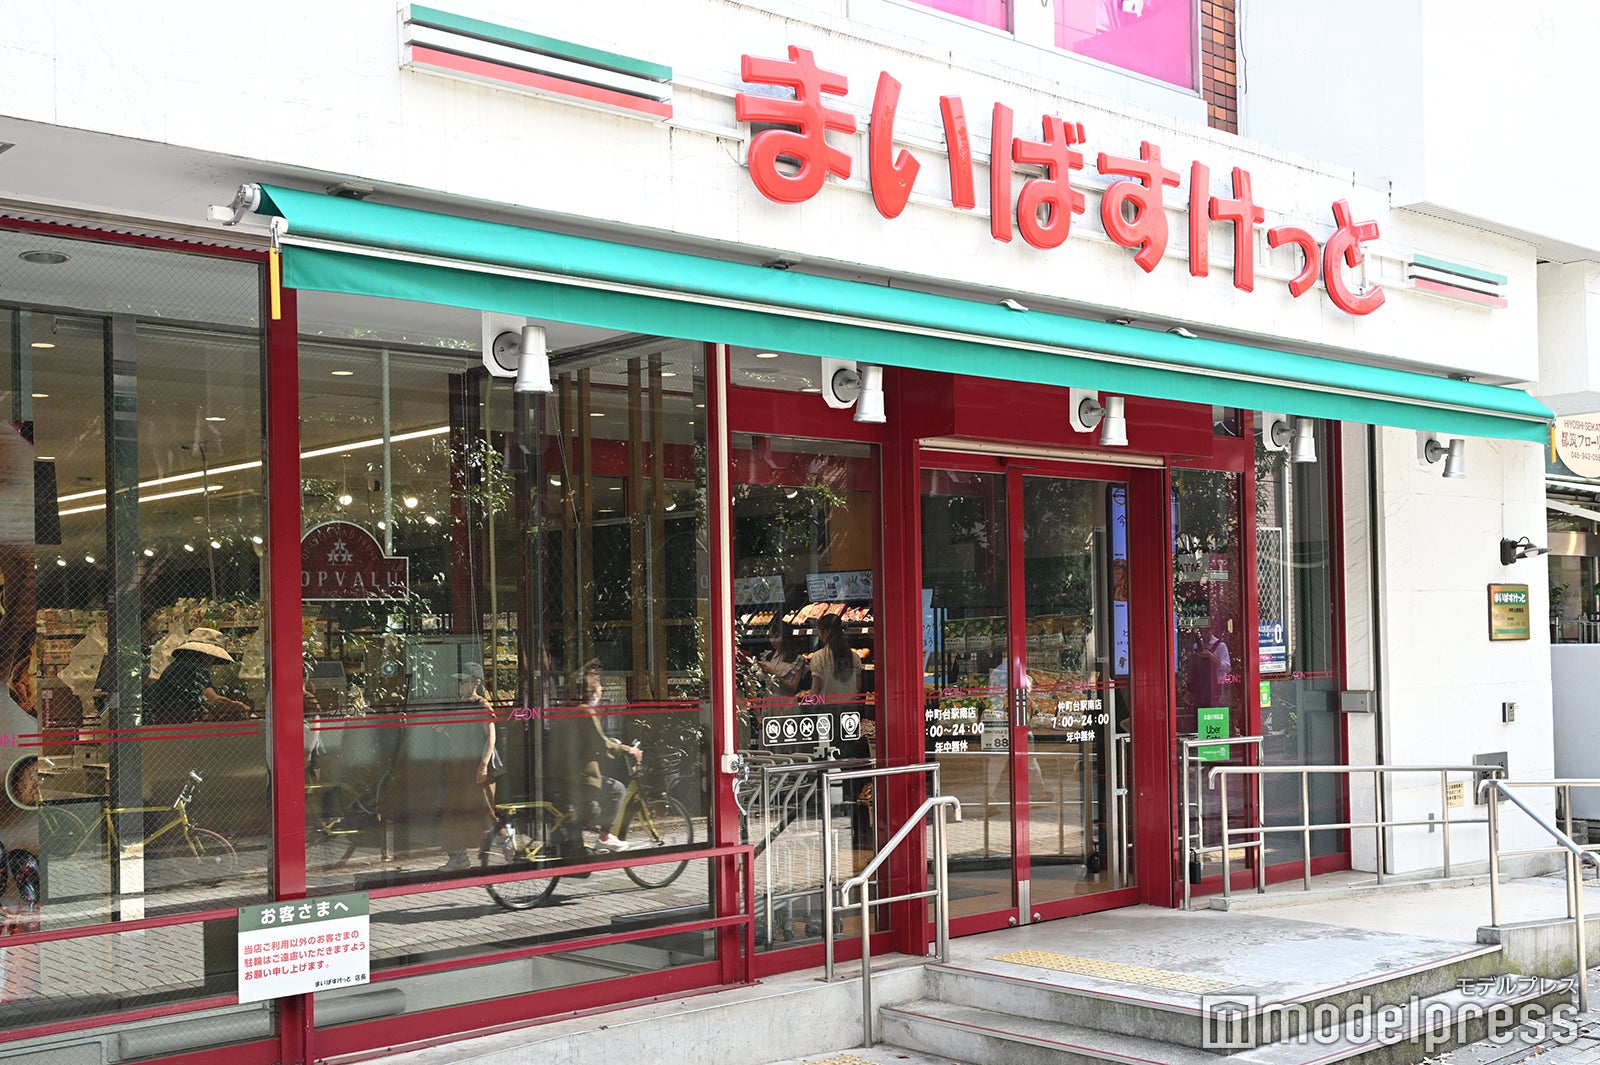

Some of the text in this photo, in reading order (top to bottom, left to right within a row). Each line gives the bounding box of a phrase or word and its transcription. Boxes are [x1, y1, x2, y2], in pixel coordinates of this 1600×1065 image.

[736, 45, 1386, 316] まいばすけっと
[925, 706, 976, 721] 仲町台駅南店
[1058, 699, 1102, 712] 仲町台駅南店
[1066, 730, 1095, 742] 年中無休
[1206, 725, 1221, 734] Uber
[935, 740, 968, 753] 年中無休
[260, 901, 350, 925] お客さまへ
[244, 930, 359, 955] 当店ご利用以外のお客さまの
[244, 941, 366, 968] 駐輪はご遠慮いただきますよう
[244, 960, 330, 981] お願い申し上げます。
